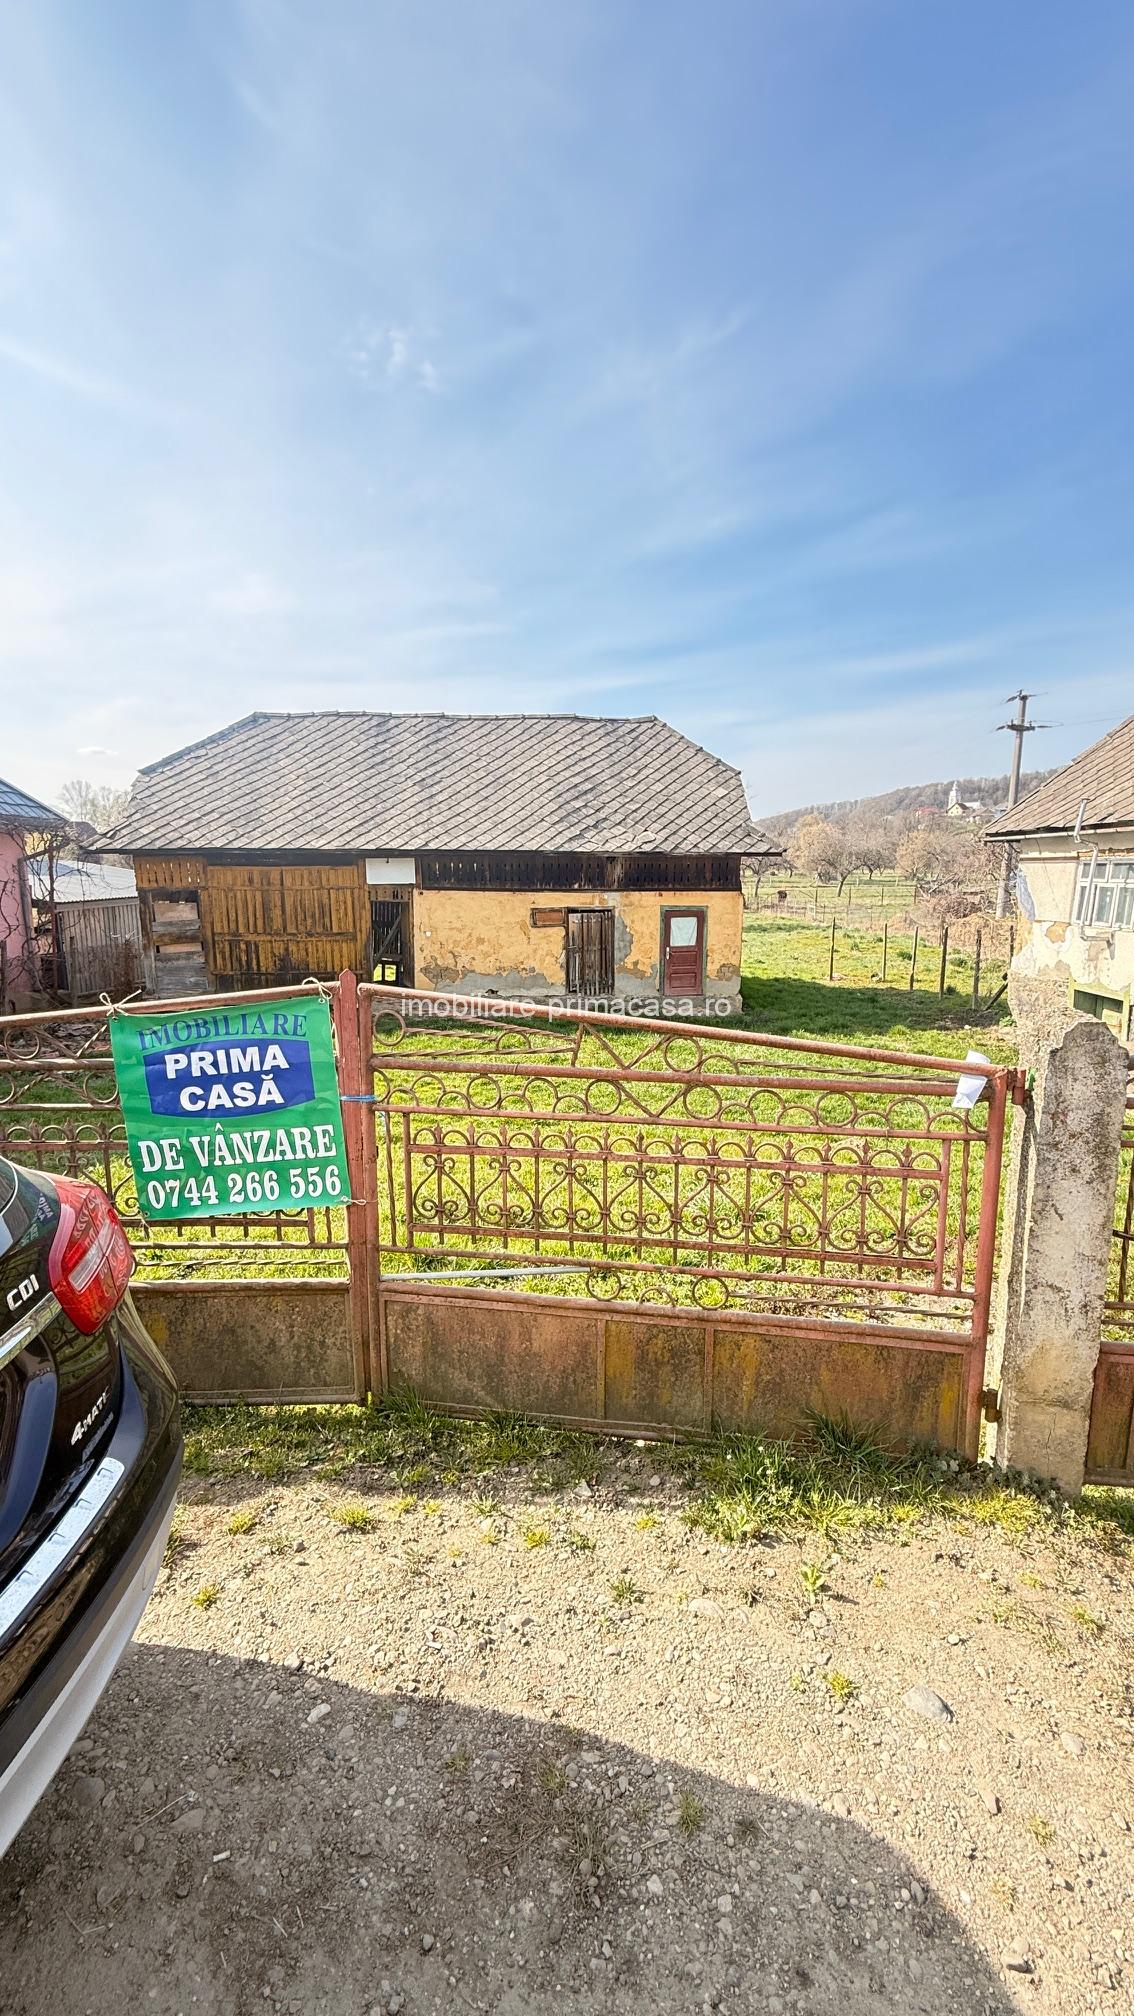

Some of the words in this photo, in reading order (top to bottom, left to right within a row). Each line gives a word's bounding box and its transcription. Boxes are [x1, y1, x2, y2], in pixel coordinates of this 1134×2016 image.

[136, 1013, 307, 1051] IMOBILIARE
[164, 1044, 289, 1079] PRIMA
[179, 1074, 285, 1112] CASĂ
[138, 1138, 184, 1172] DE
[189, 1123, 337, 1168] VÂNZARE
[147, 1175, 218, 1210] 0744
[227, 1170, 280, 1203] 266
[288, 1165, 341, 1199] 556
[6, 1274, 40, 1311] CDI
